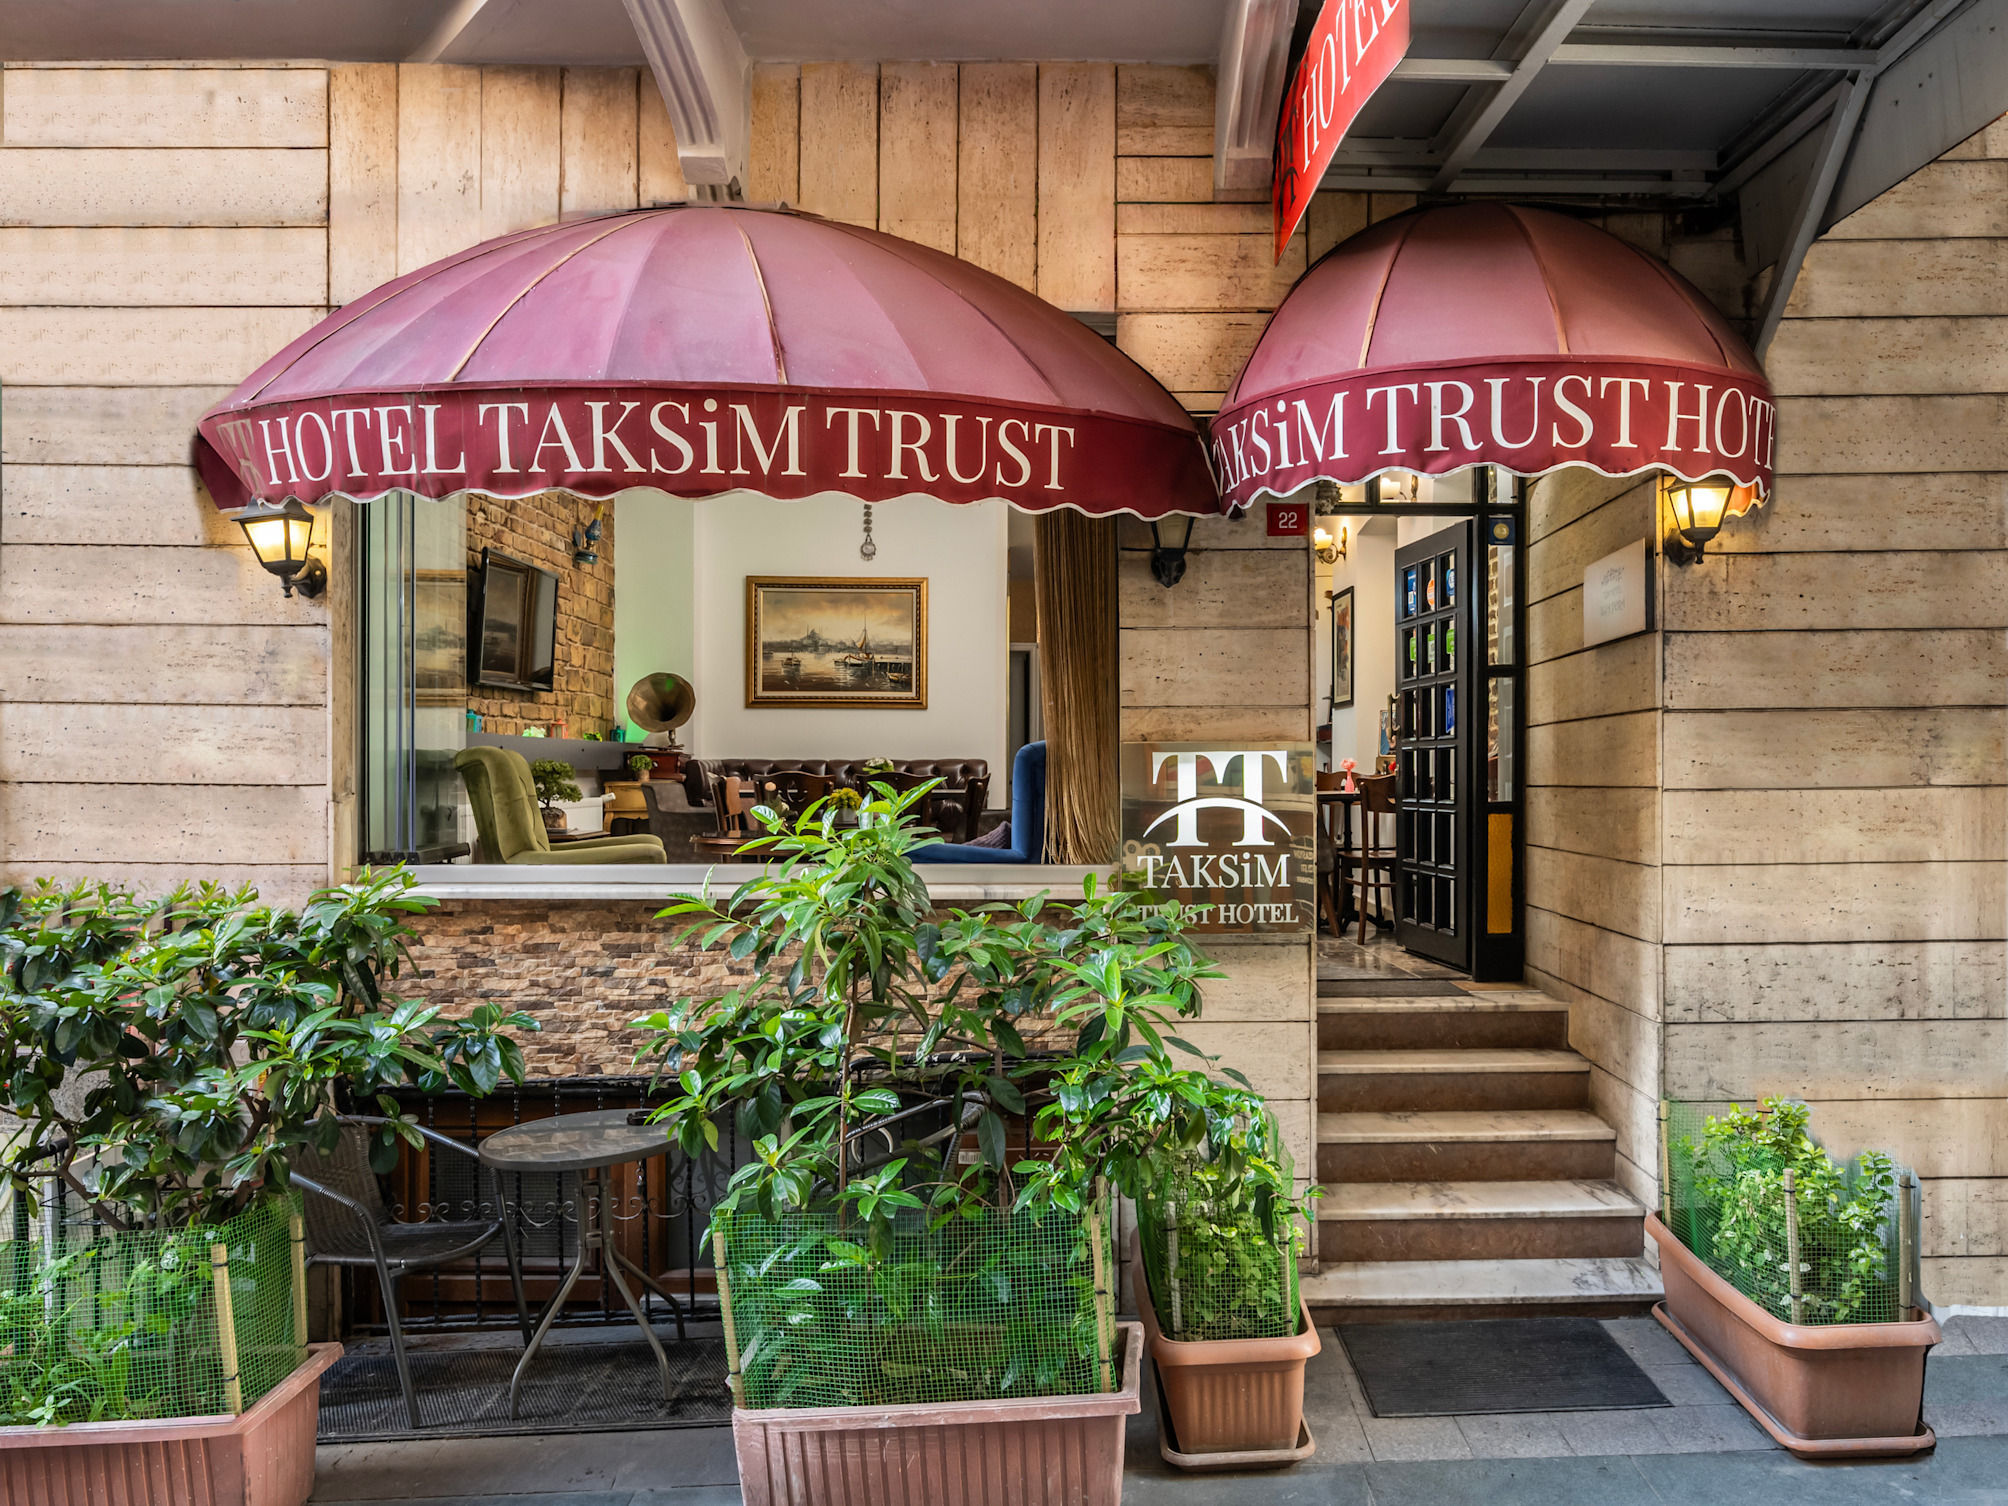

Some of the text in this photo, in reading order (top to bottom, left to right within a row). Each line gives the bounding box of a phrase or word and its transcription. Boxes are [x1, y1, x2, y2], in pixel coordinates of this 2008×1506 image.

[1367, 375, 1649, 456] TRUST
[258, 404, 466, 486] HOTEL
[826, 406, 1075, 491] TRUST
[1278, 511, 1298, 529] 22
[1137, 903, 1300, 925] TST HOTEL
